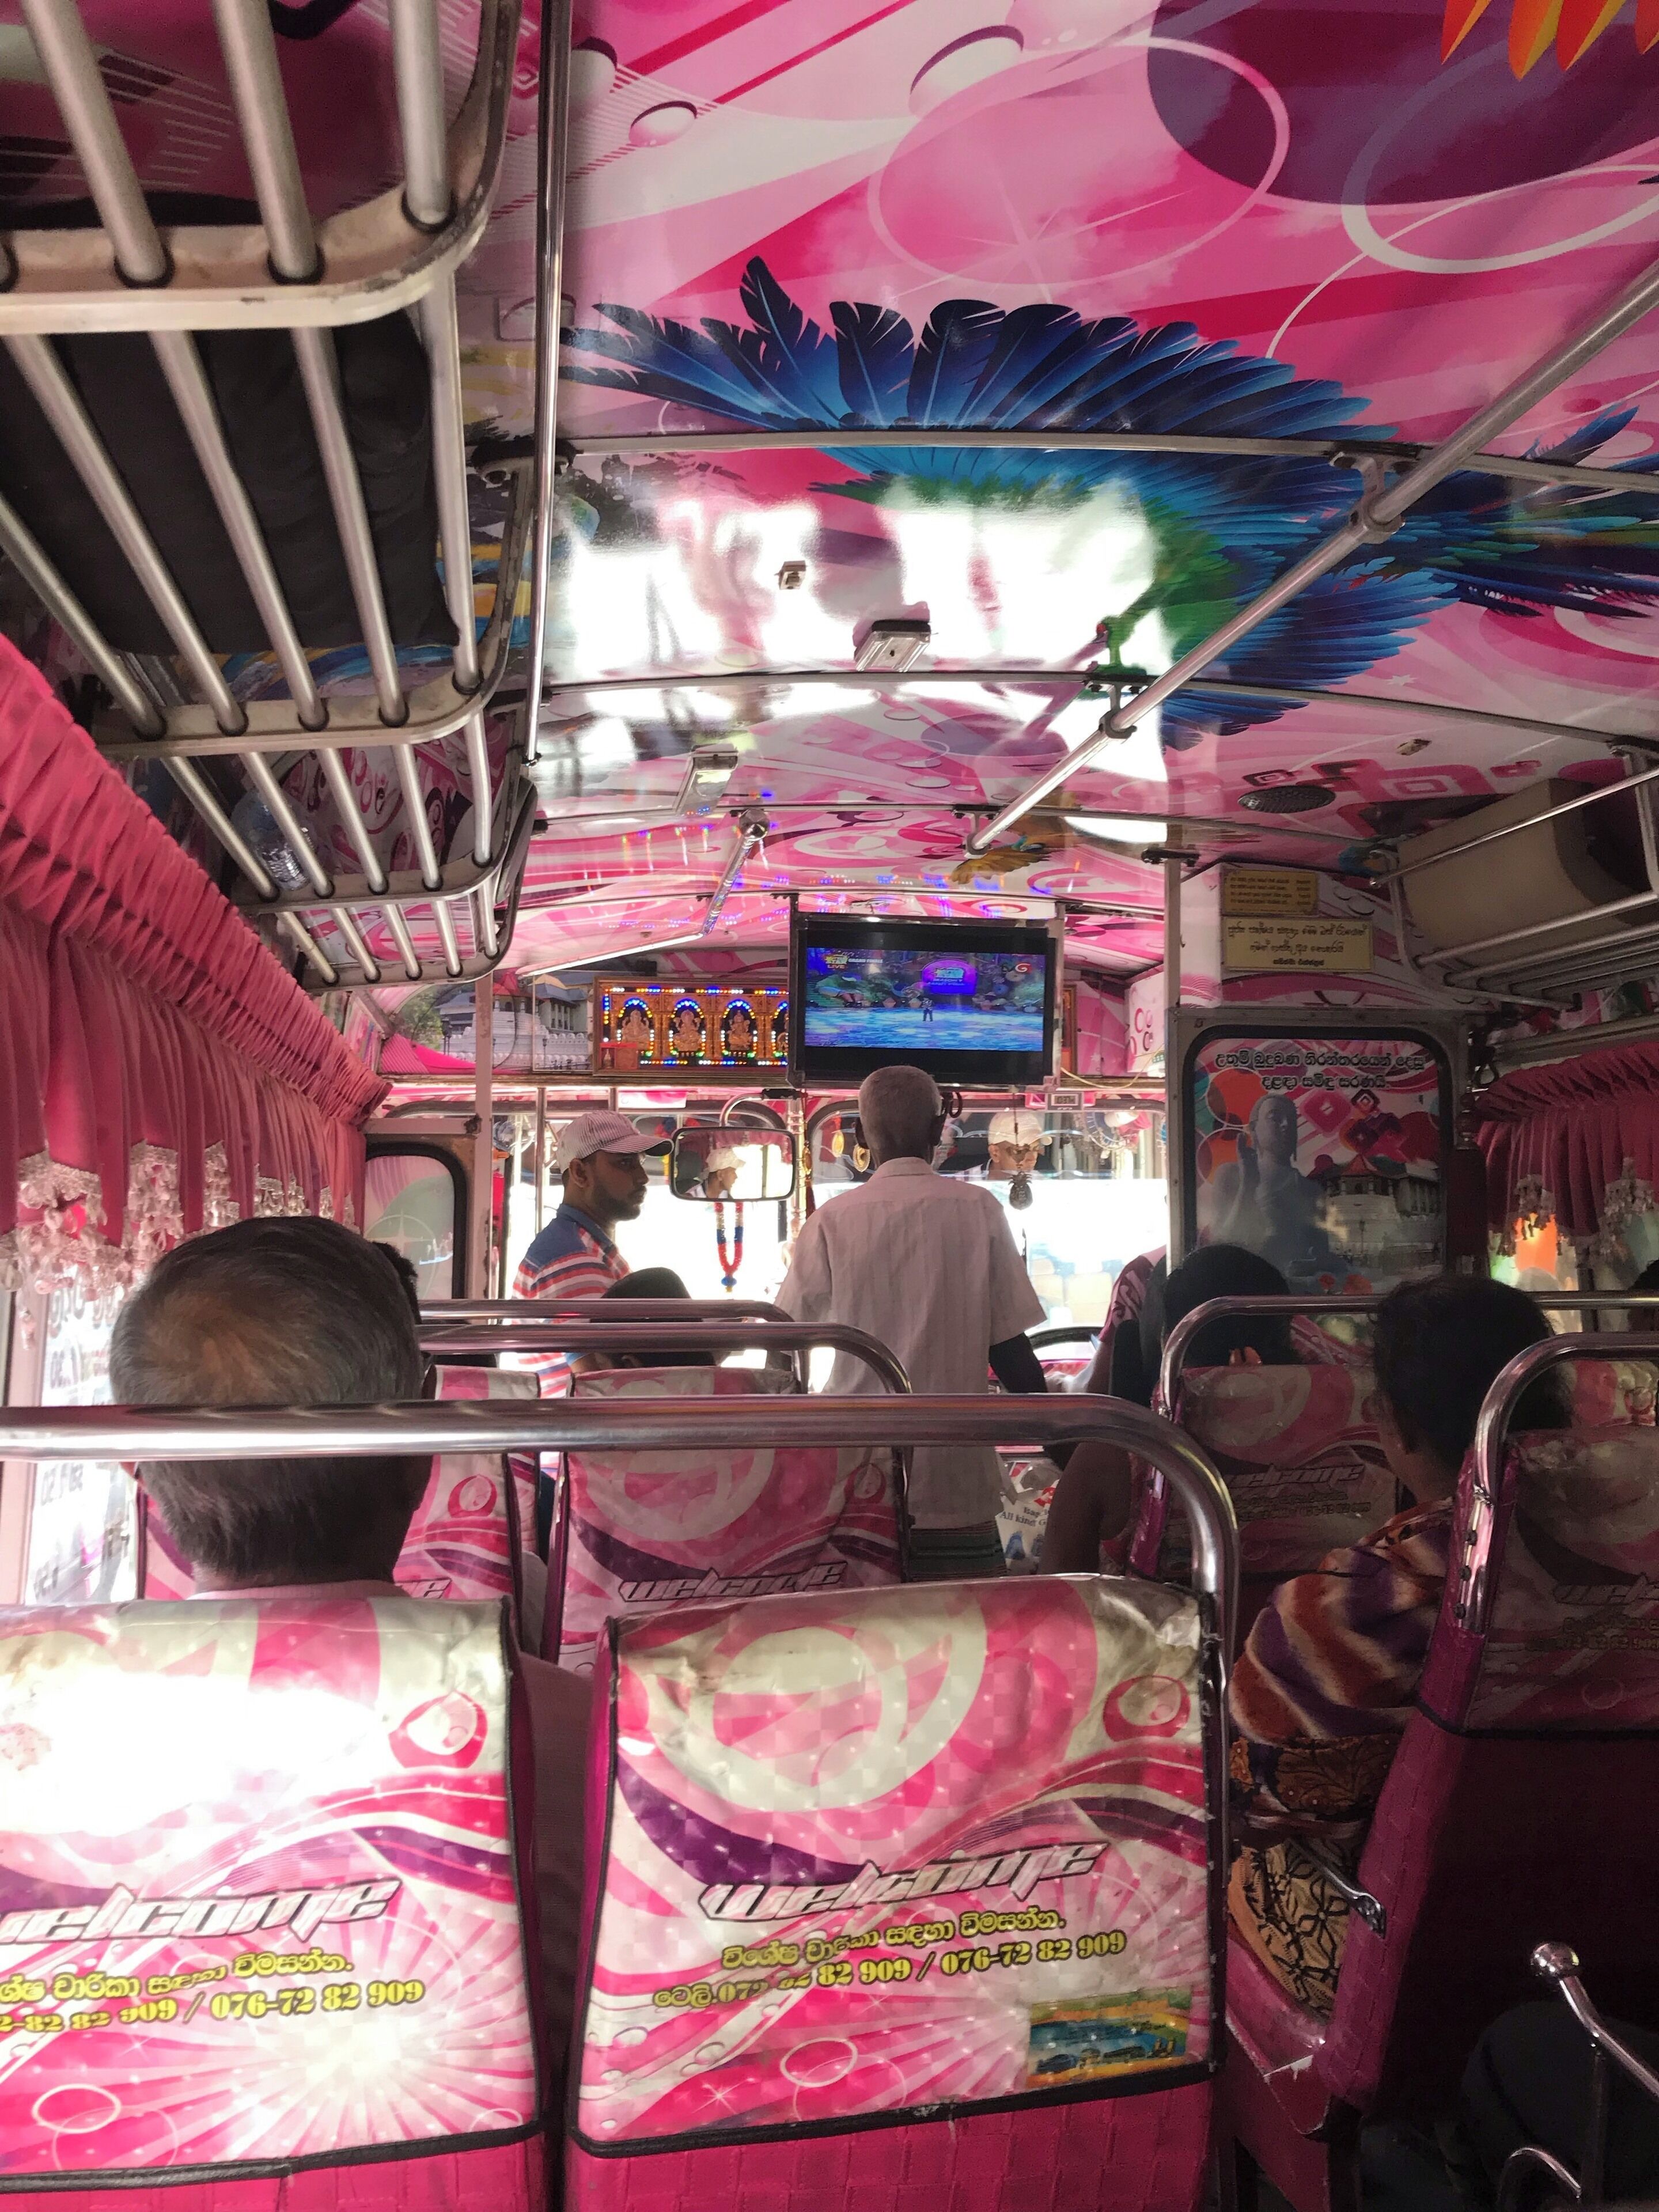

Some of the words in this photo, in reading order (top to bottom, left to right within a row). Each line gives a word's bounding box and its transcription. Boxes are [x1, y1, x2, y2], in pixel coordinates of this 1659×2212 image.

[698, 1842, 1110, 1922] welcome
[816, 1959, 854, 1988] 82
[858, 1957, 913, 1985] 909
[940, 1941, 1032, 1976] 076-72
[1036, 1938, 1072, 1962] 82
[1075, 1929, 1128, 1959] 909
[69, 2010, 112, 2031] 82
[118, 1997, 179, 2024] 909
[209, 1985, 317, 2022] 076-72
[321, 1982, 362, 2012] 82
[366, 1978, 426, 2008] 909
